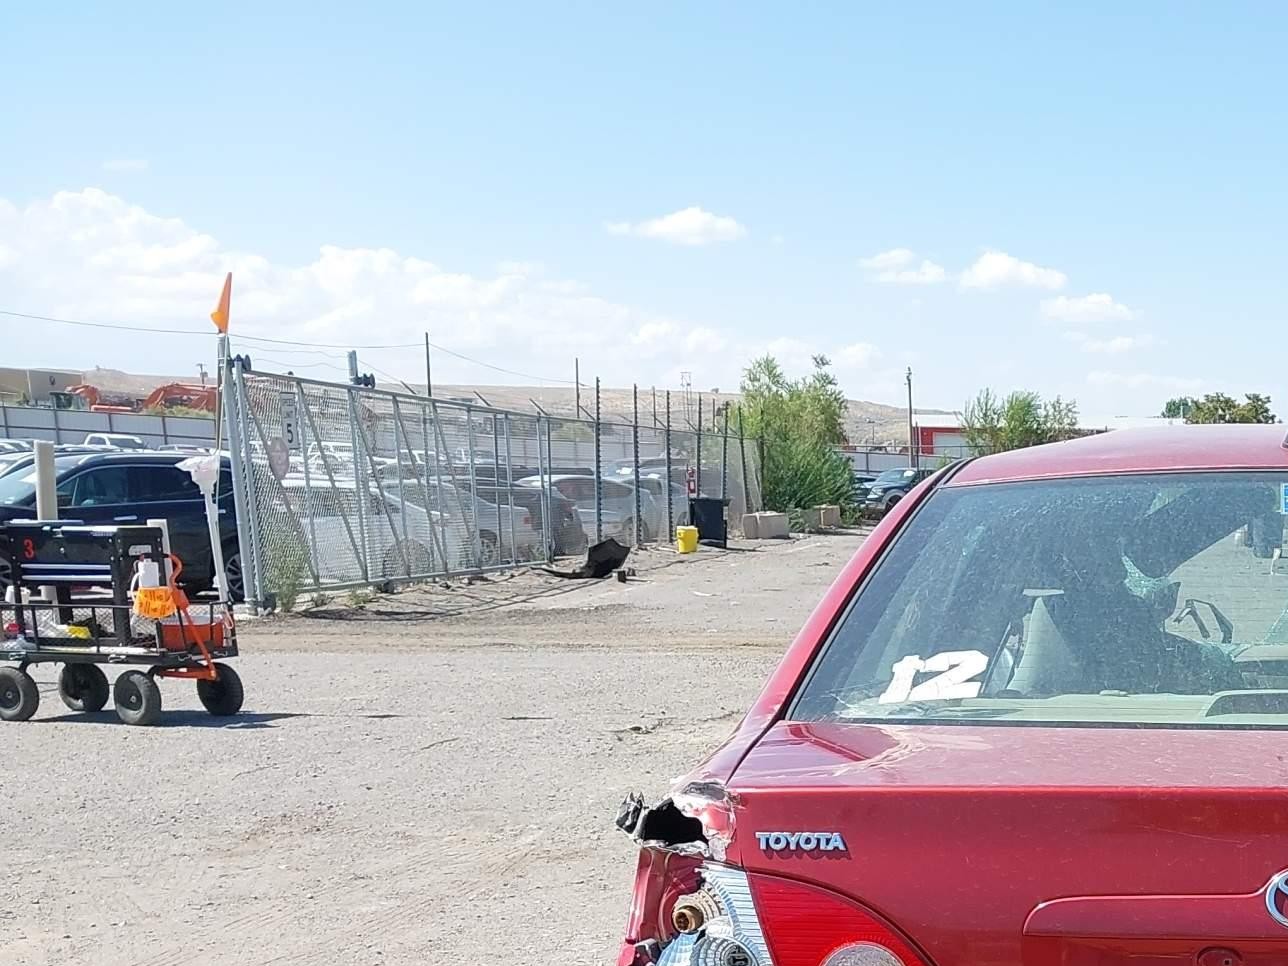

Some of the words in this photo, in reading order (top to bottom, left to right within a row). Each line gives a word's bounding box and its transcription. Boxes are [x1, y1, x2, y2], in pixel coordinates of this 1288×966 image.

[286, 423, 294, 443] 5
[23, 538, 36, 558] 3
[878, 650, 989, 704] 12
[755, 832, 847, 851] TOYOTA
